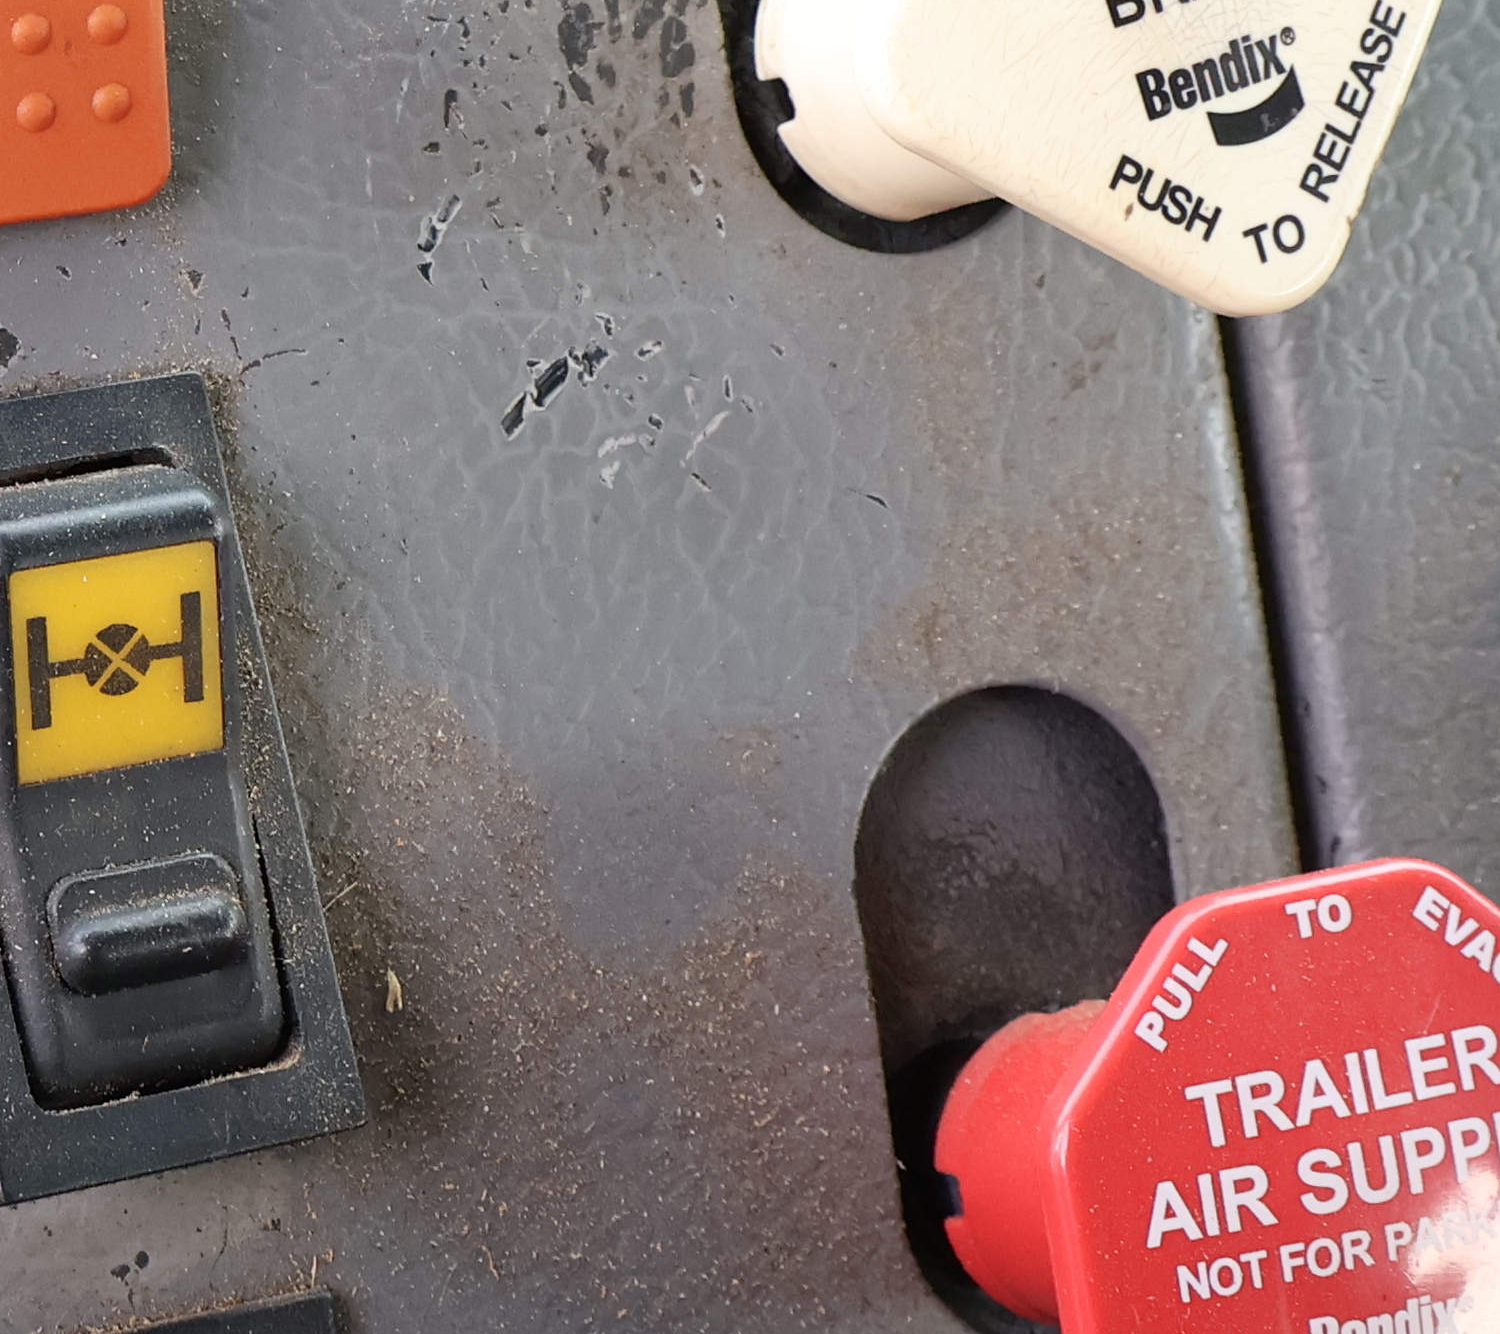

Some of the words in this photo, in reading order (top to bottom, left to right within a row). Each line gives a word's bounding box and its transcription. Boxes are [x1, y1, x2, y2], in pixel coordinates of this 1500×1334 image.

[1109, 154, 1222, 242] PUSH
[1243, 214, 1306, 264] TO
[1299, 0, 1407, 203] RELEASE
[1135, 935, 1229, 1053] PULL
[1285, 894, 1352, 939] TO
[1146, 1164, 1278, 1250] AIR
[1176, 1250, 1267, 1304] NOT
[1279, 1229, 1374, 1283] FOR
